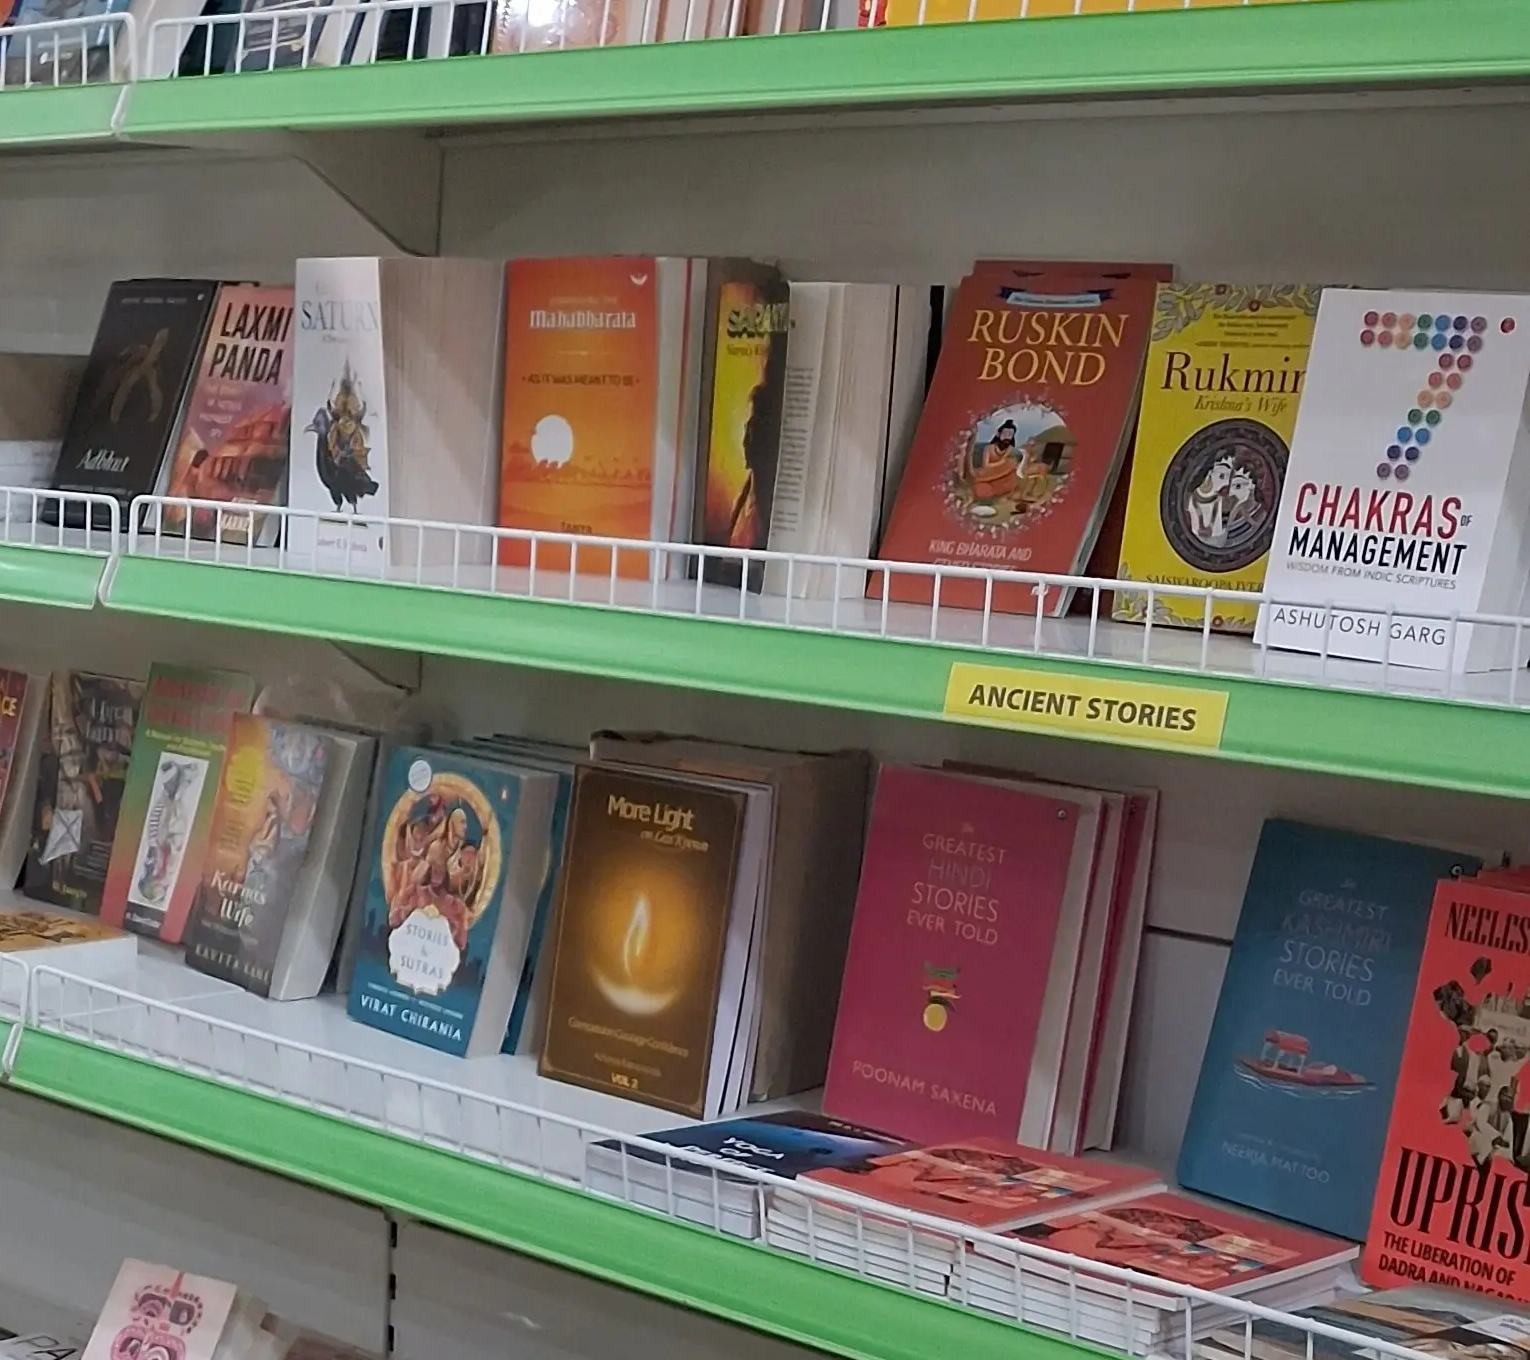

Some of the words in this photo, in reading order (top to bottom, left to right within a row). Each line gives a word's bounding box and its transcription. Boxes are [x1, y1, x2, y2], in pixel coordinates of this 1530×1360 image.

[220, 302, 293, 342] LAXMI
[301, 300, 378, 332] SATURN
[529, 309, 637, 329] Mahabharata
[968, 310, 1129, 348] RUSKIN
[209, 343, 284, 385] PANDA
[978, 349, 1106, 386] BOND
[1258, 396, 1289, 417] Wife
[1295, 482, 1462, 539] CHAKRAS
[1461, 513, 1473, 527] OF
[928, 539, 955, 554] KING
[956, 542, 1007, 558] BHARATA
[1008, 546, 1032, 561] AND
[1288, 526, 1467, 576] MANAGEMENT
[1286, 561, 1329, 576] WISDOM
[1331, 565, 1361, 578] FROM
[1364, 569, 1392, 583] INDIC
[1395, 572, 1457, 590] SCRIPTURES
[1273, 607, 1381, 637] ASHUTOSH
[1388, 622, 1447, 646] GARG
[968, 684, 1081, 719] ANCIENT
[1086, 697, 1197, 732] STORIES
[607, 794, 651, 822] More
[654, 803, 695, 831] Light
[923, 833, 1007, 863] GREATEST
[928, 861, 992, 890] HINDI
[220, 898, 254, 928] Wife
[912, 882, 998, 923] STORIES
[1299, 889, 1388, 920] GREATEST
[406, 922, 448, 947] STORIES
[907, 910, 945, 933] EVER
[954, 922, 998, 946] TOLD
[1444, 901, 1530, 956] NEELES
[400, 955, 444, 981] SUTRAS
[1280, 939, 1375, 982] STORIES
[1273, 968, 1314, 995] EVER
[1324, 979, 1372, 1006] TOLD
[360, 994, 395, 1019] VIRAT
[401, 1008, 463, 1041] CHIRANIA
[851, 1061, 925, 1094] POONAM
[930, 1084, 997, 1117] SAXENA
[1390, 1147, 1530, 1265] UPRIS
[1379, 1253, 1426, 1283] DADRA
[1383, 1230, 1409, 1254] THE
[1411, 1240, 1494, 1281] LIBERATION
[1495, 1267, 1517, 1287] OF
